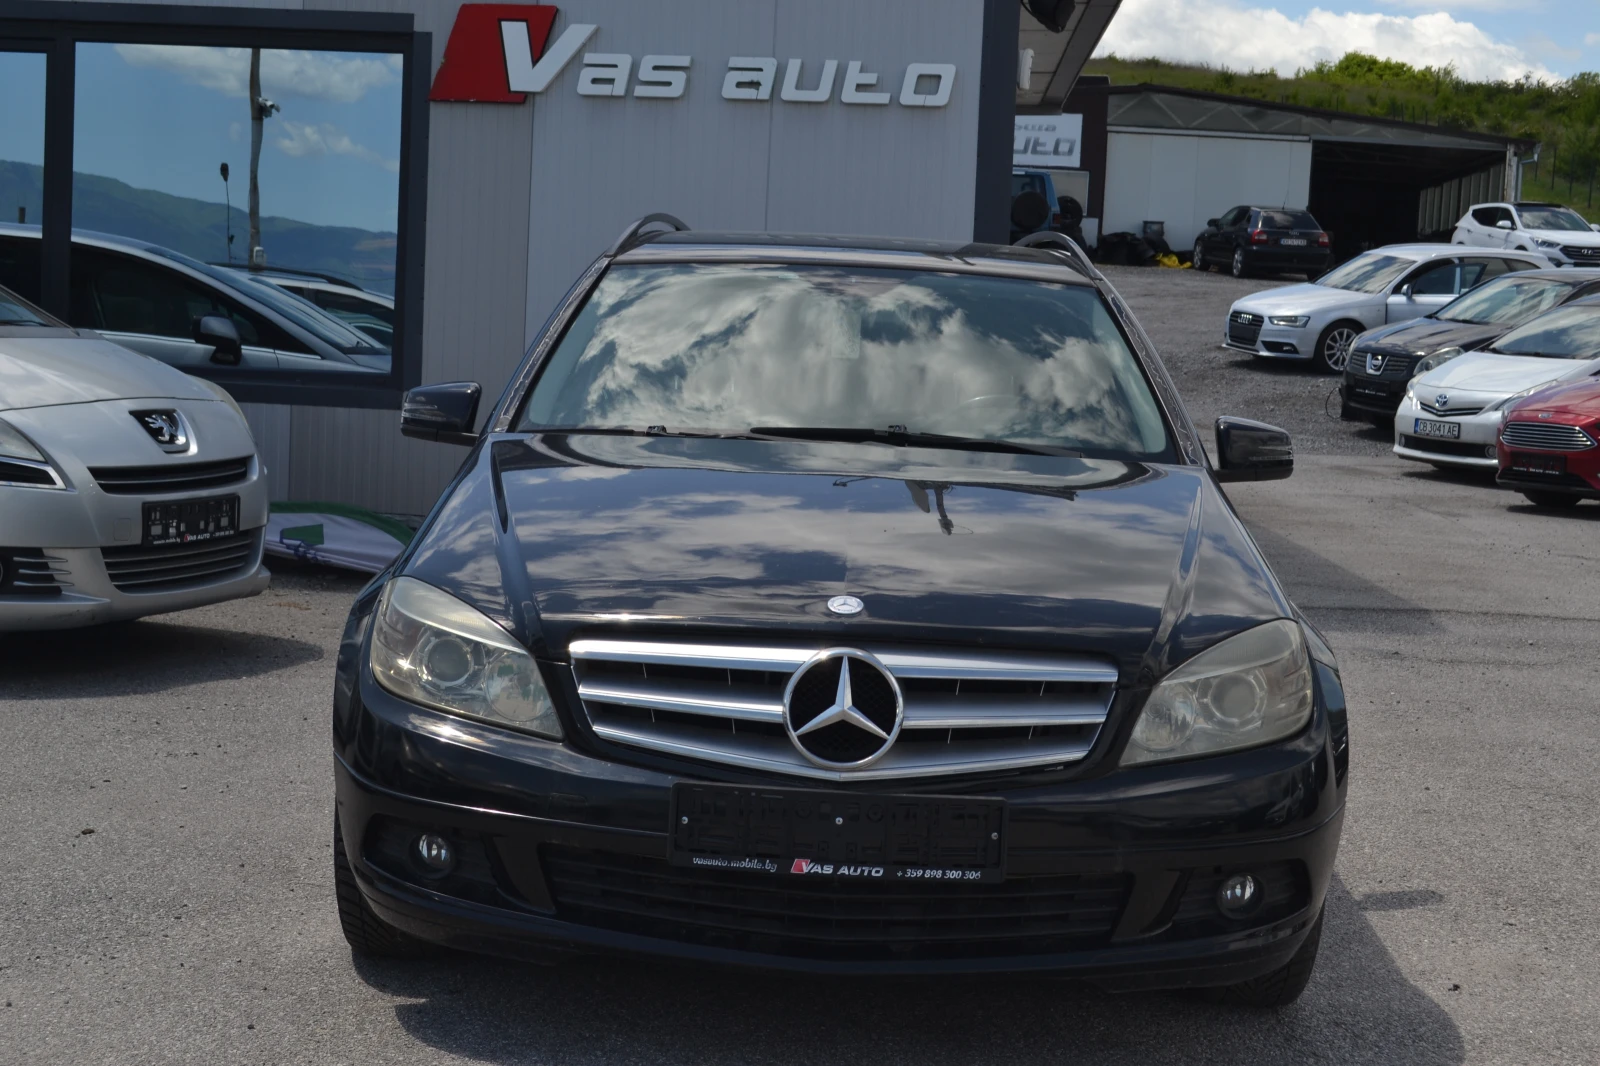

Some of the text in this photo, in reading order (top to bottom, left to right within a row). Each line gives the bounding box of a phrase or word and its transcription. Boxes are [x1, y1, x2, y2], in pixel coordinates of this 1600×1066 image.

[500, 20, 957, 107] Vas auto
[693, 857, 777, 872] vasauto.mobile.bg
[801, 861, 884, 877] VAS AUTO
